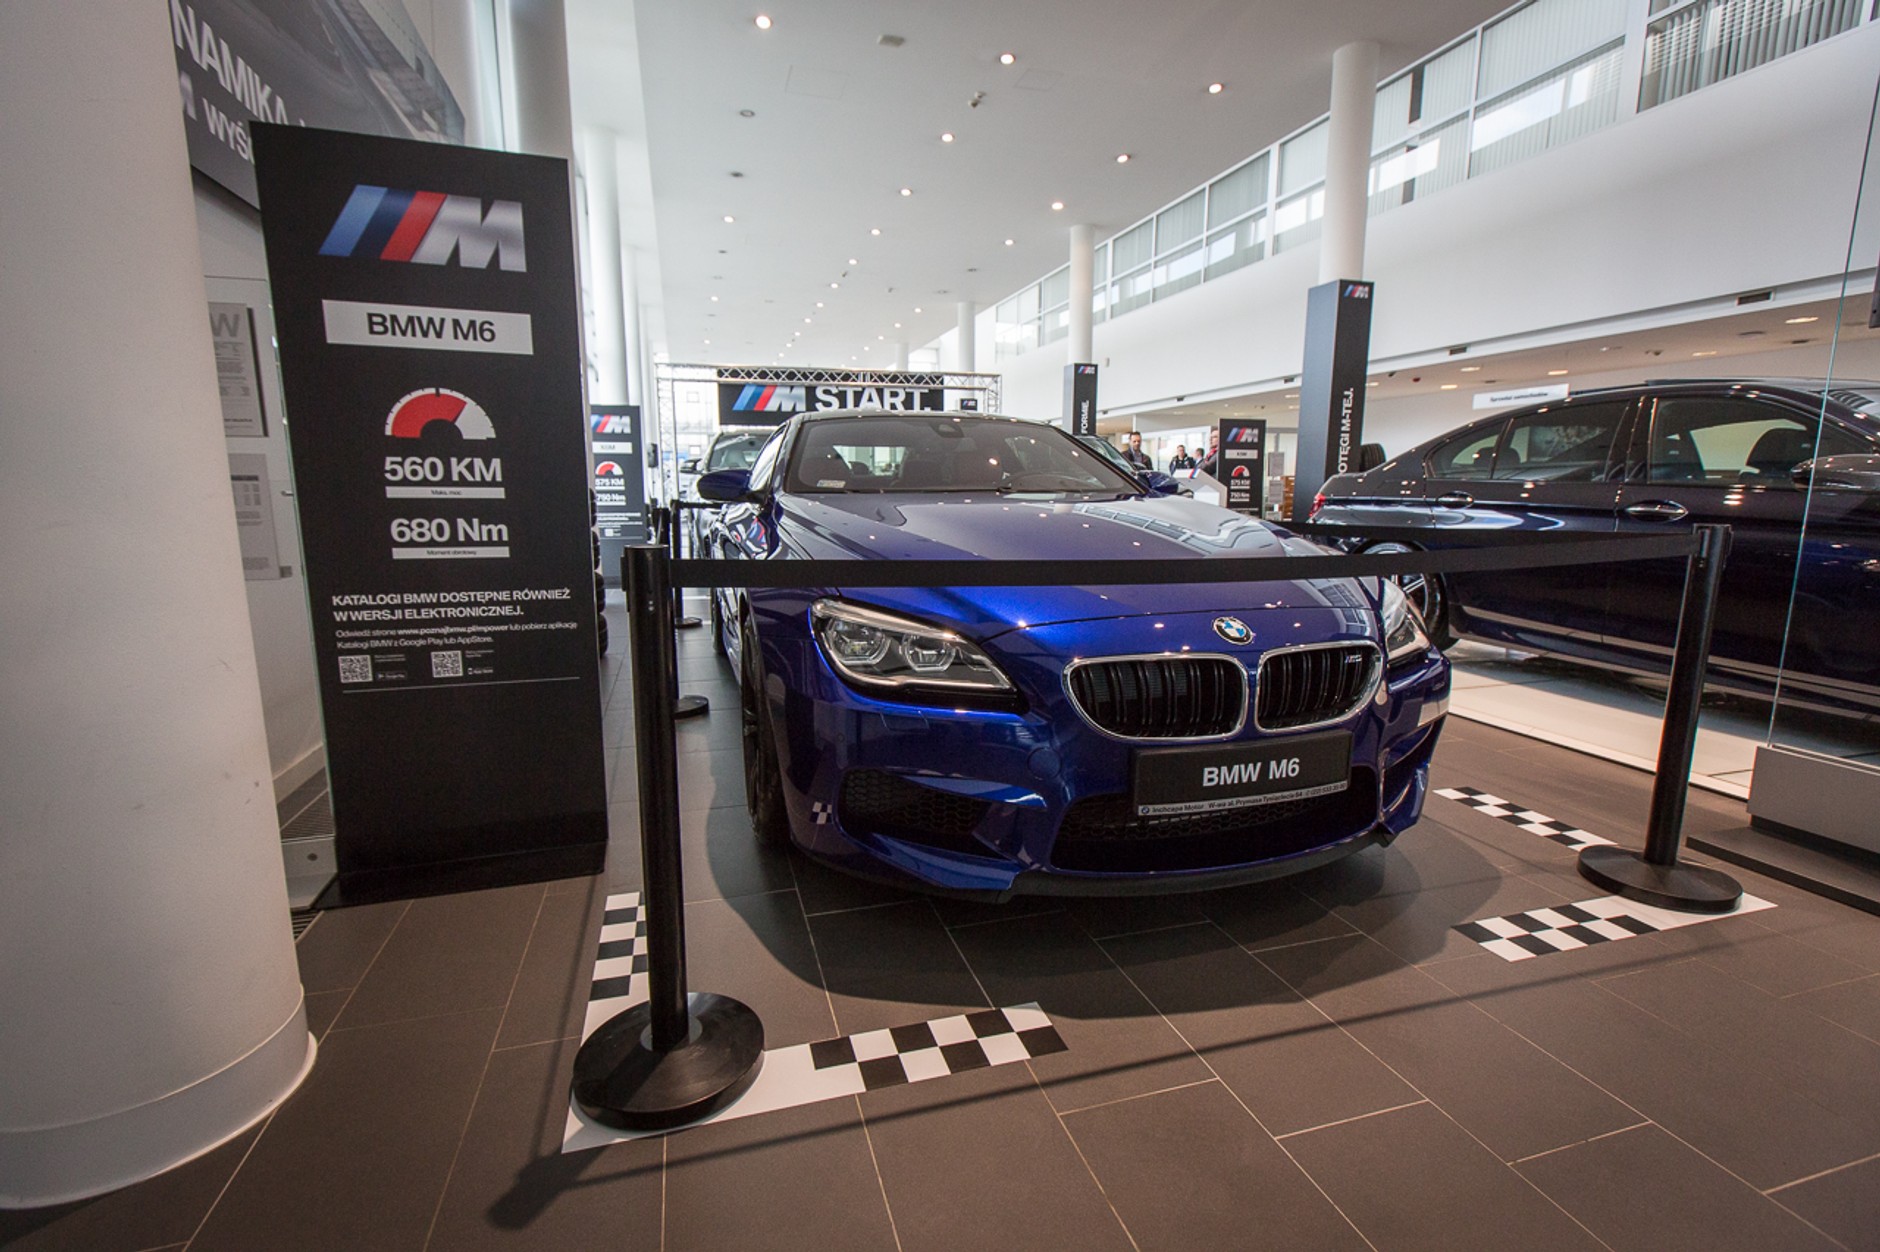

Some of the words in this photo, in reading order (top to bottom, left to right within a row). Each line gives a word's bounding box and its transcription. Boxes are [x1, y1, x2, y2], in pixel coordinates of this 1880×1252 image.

[366, 312, 446, 339] BMW
[452, 318, 496, 342] M6
[815, 387, 931, 411] START.
[384, 456, 444, 481] 560
[450, 457, 502, 482] KM
[390, 518, 450, 542] 680
[457, 518, 509, 541] Nm
[332, 594, 401, 606] KATALOGI
[403, 592, 438, 604] BMW
[440, 589, 511, 604] DOSTĘPNE
[513, 587, 571, 600] RÓWNIEŻ
[333, 610, 348, 622] W
[350, 609, 402, 621] WERSJI
[405, 605, 524, 620] ELEKTRONICZNEJ.
[399, 638, 427, 647] Google
[1202, 762, 1262, 787] BMW
[1268, 757, 1300, 780] M6
